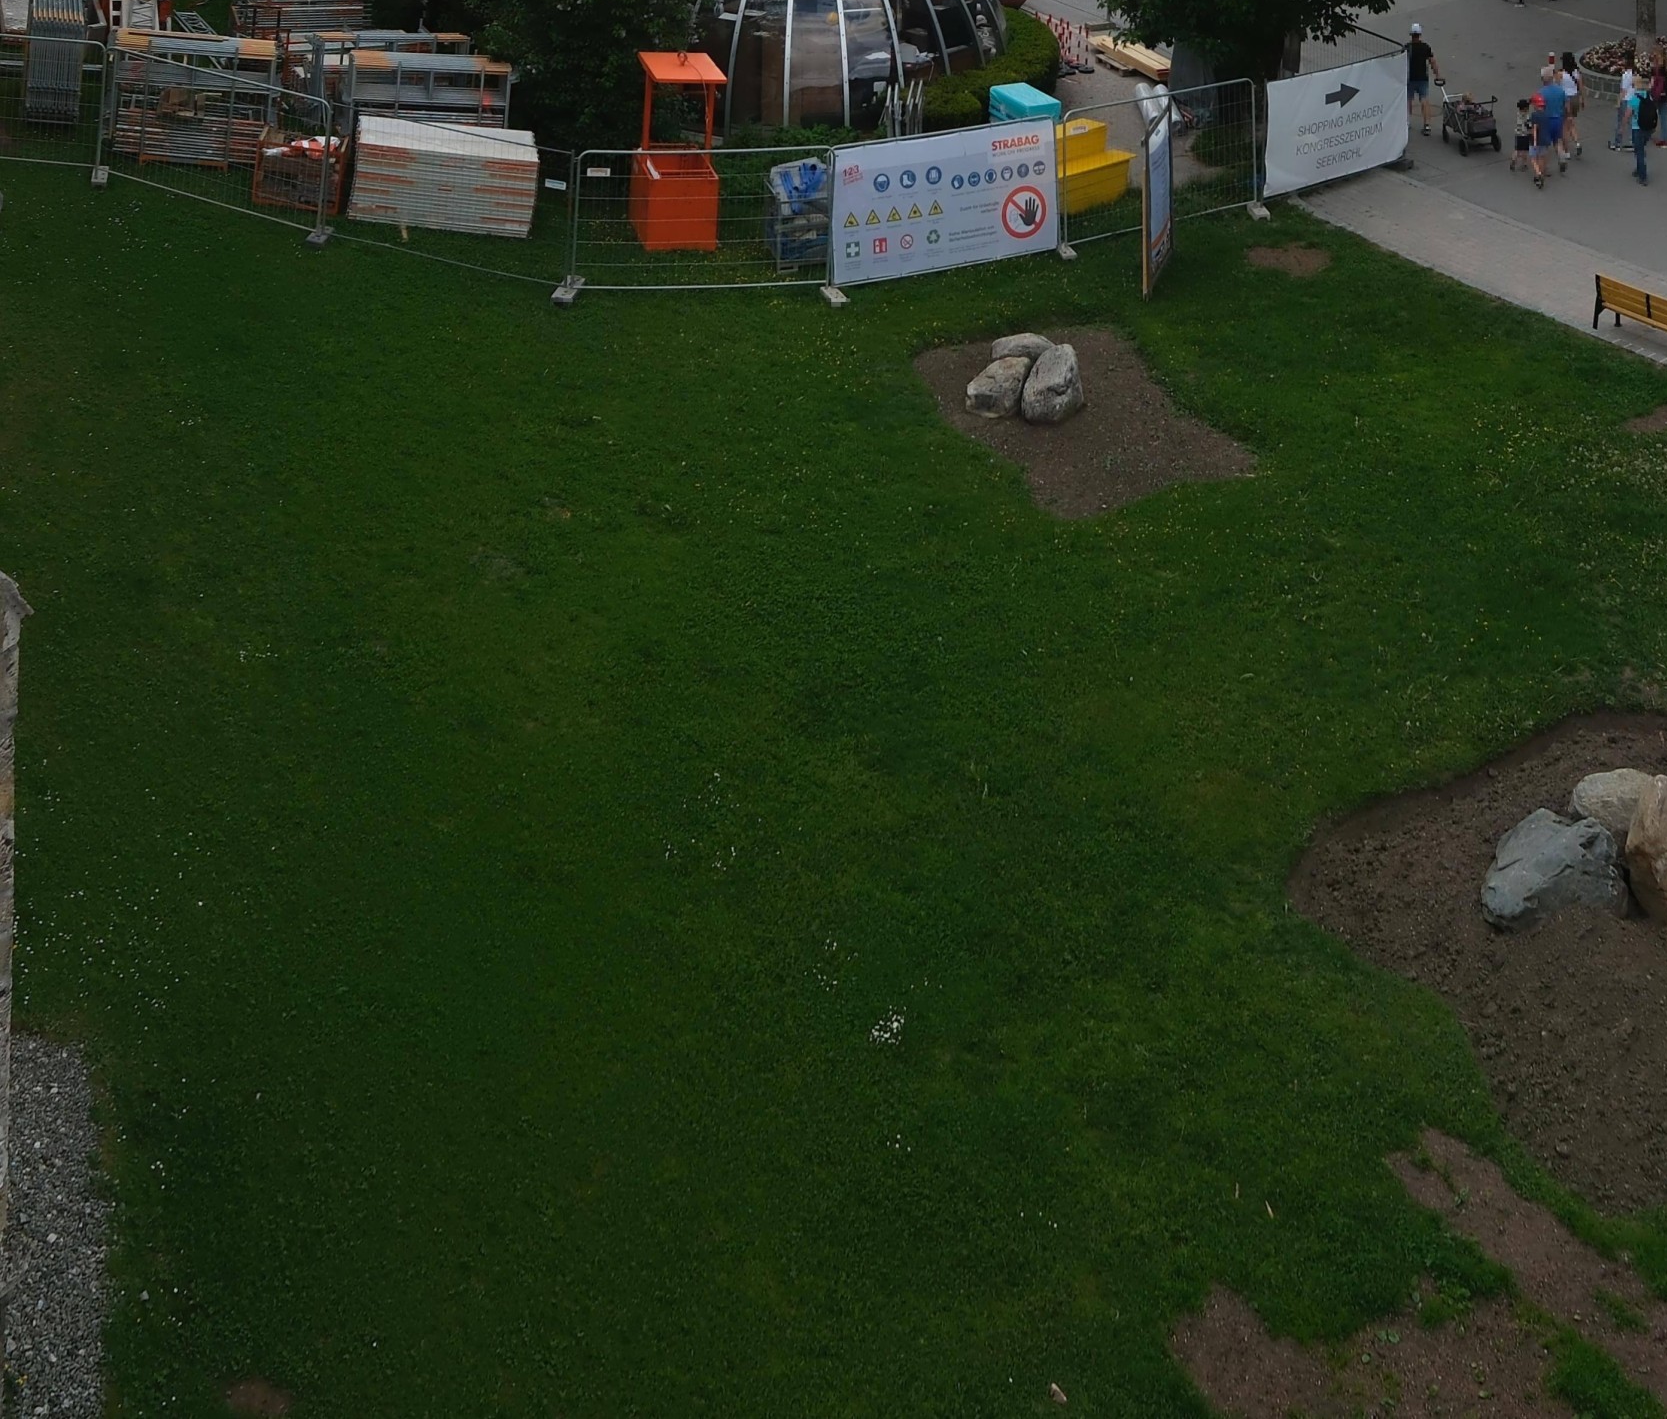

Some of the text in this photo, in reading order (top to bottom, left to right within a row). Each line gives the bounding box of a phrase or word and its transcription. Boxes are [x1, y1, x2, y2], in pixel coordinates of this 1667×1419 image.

[1297, 104, 1384, 137] SHOPPING ARKADEN
[991, 134, 1040, 152] STRABAG
[1295, 122, 1383, 156] KONGRESSZENTRUM
[1315, 147, 1363, 169] SEEKIRCHL
